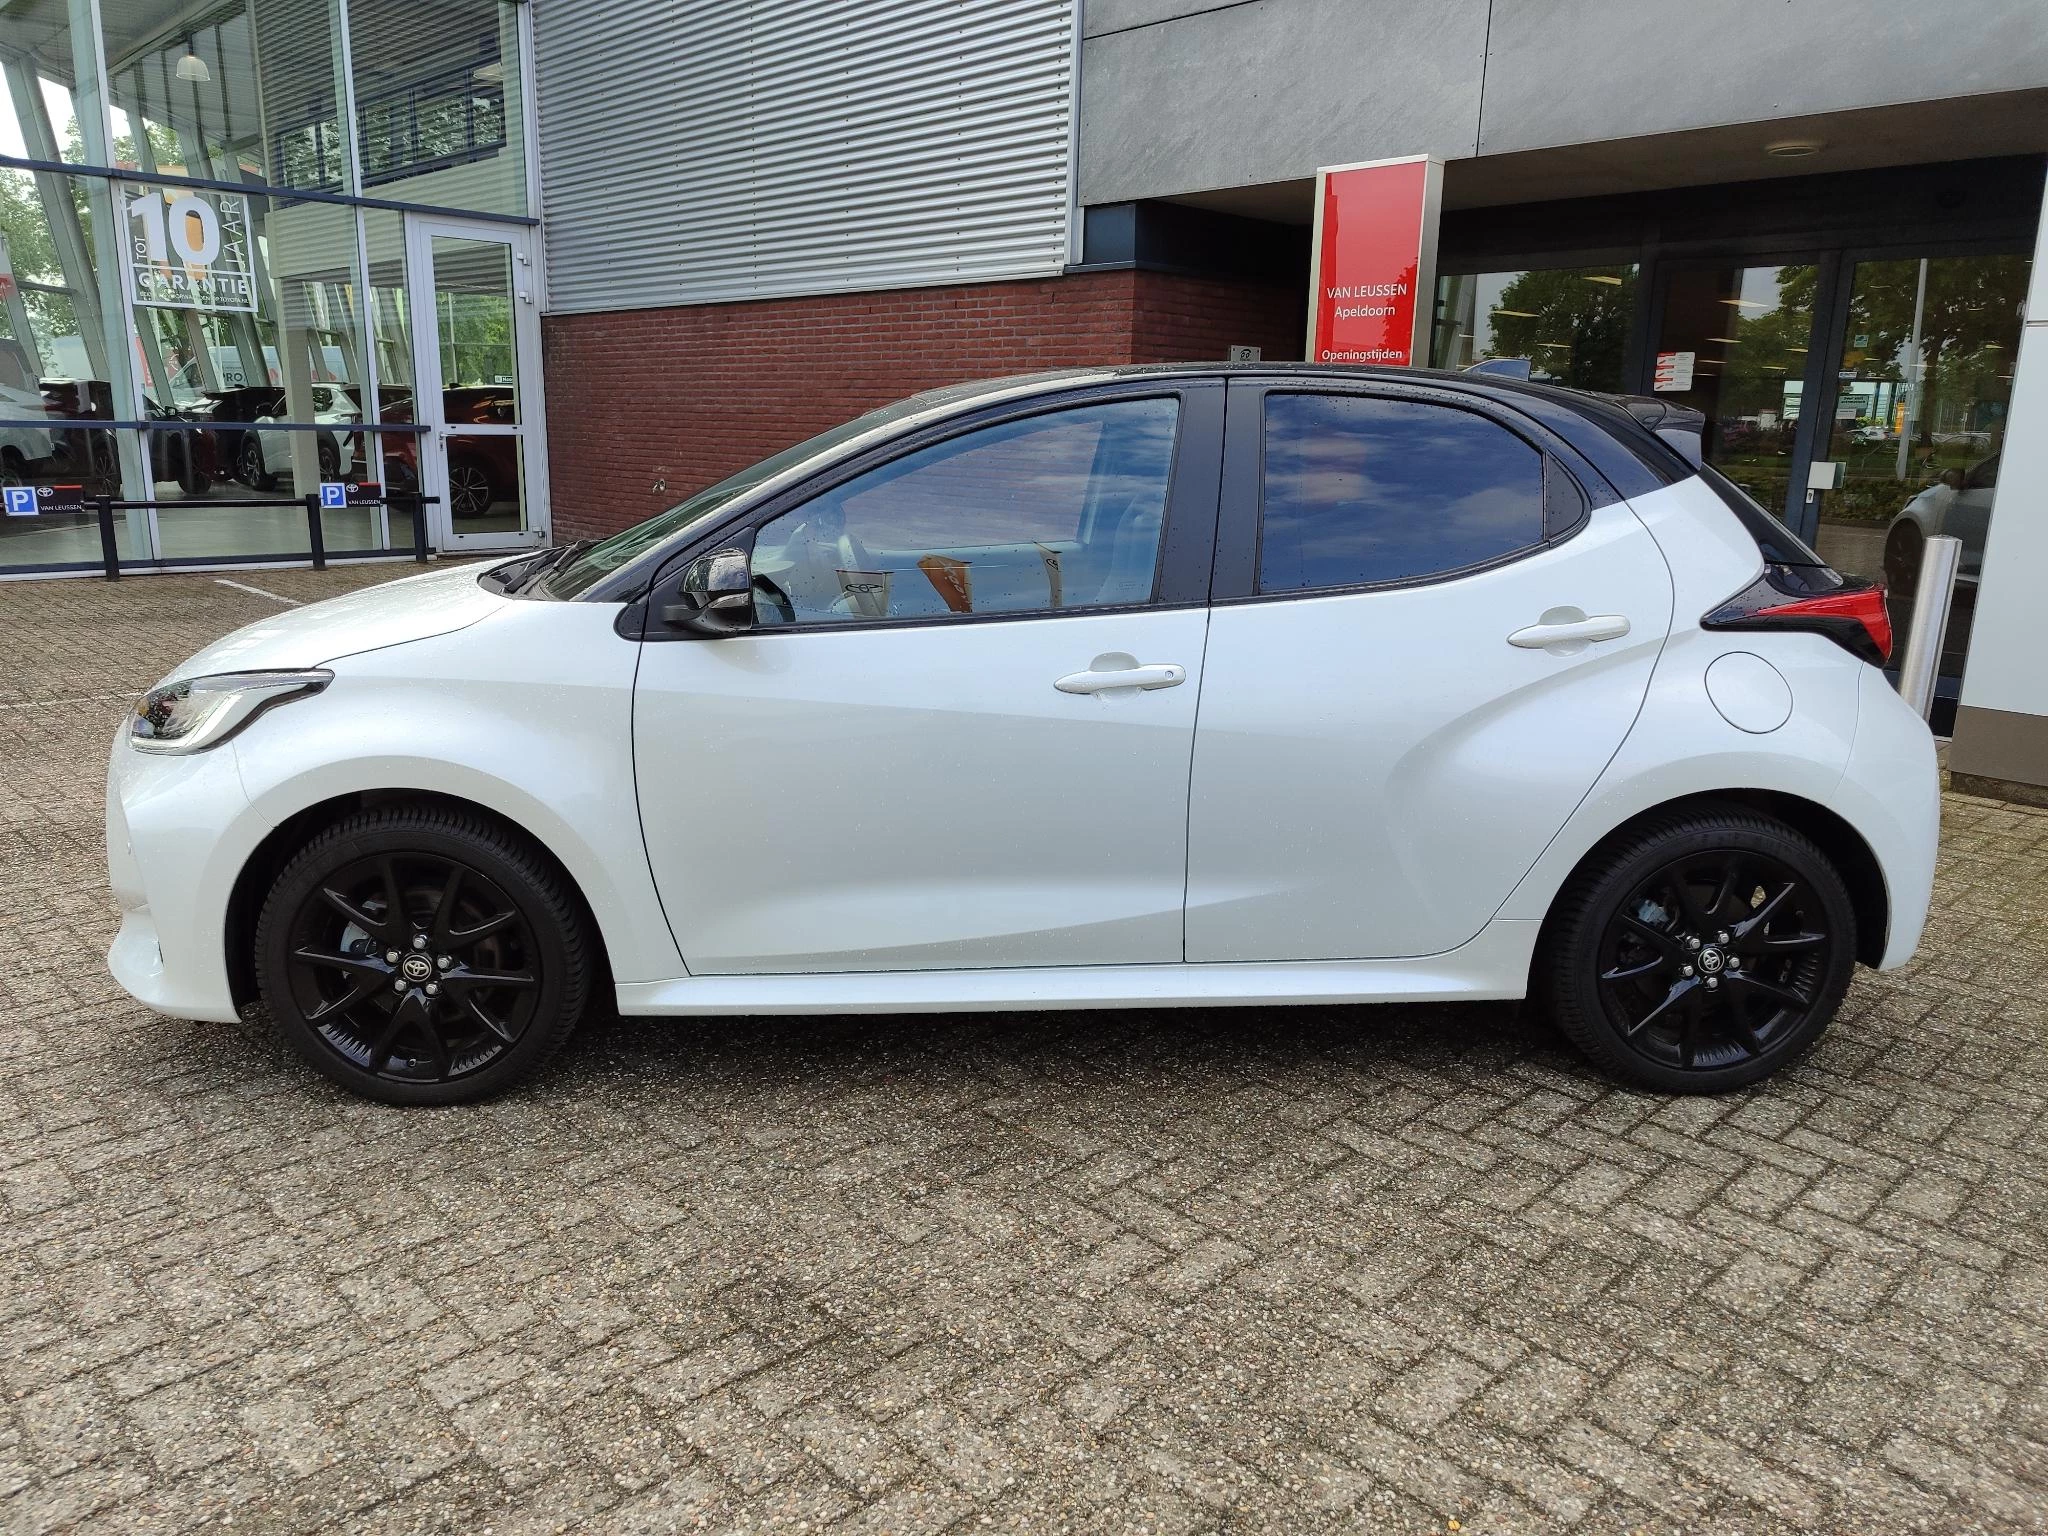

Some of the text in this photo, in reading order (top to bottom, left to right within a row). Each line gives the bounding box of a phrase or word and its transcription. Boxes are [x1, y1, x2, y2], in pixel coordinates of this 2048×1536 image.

[131, 192, 220, 265] 10
[220, 200, 246, 269] JAAR
[134, 235, 148, 261] TOT
[1326, 283, 1407, 299] VAN LEUSSEN
[1334, 304, 1396, 320] Apeldoorn
[1321, 348, 1403, 363] Openingstijden
[11, 491, 29, 512] P
[326, 486, 340, 505] P
